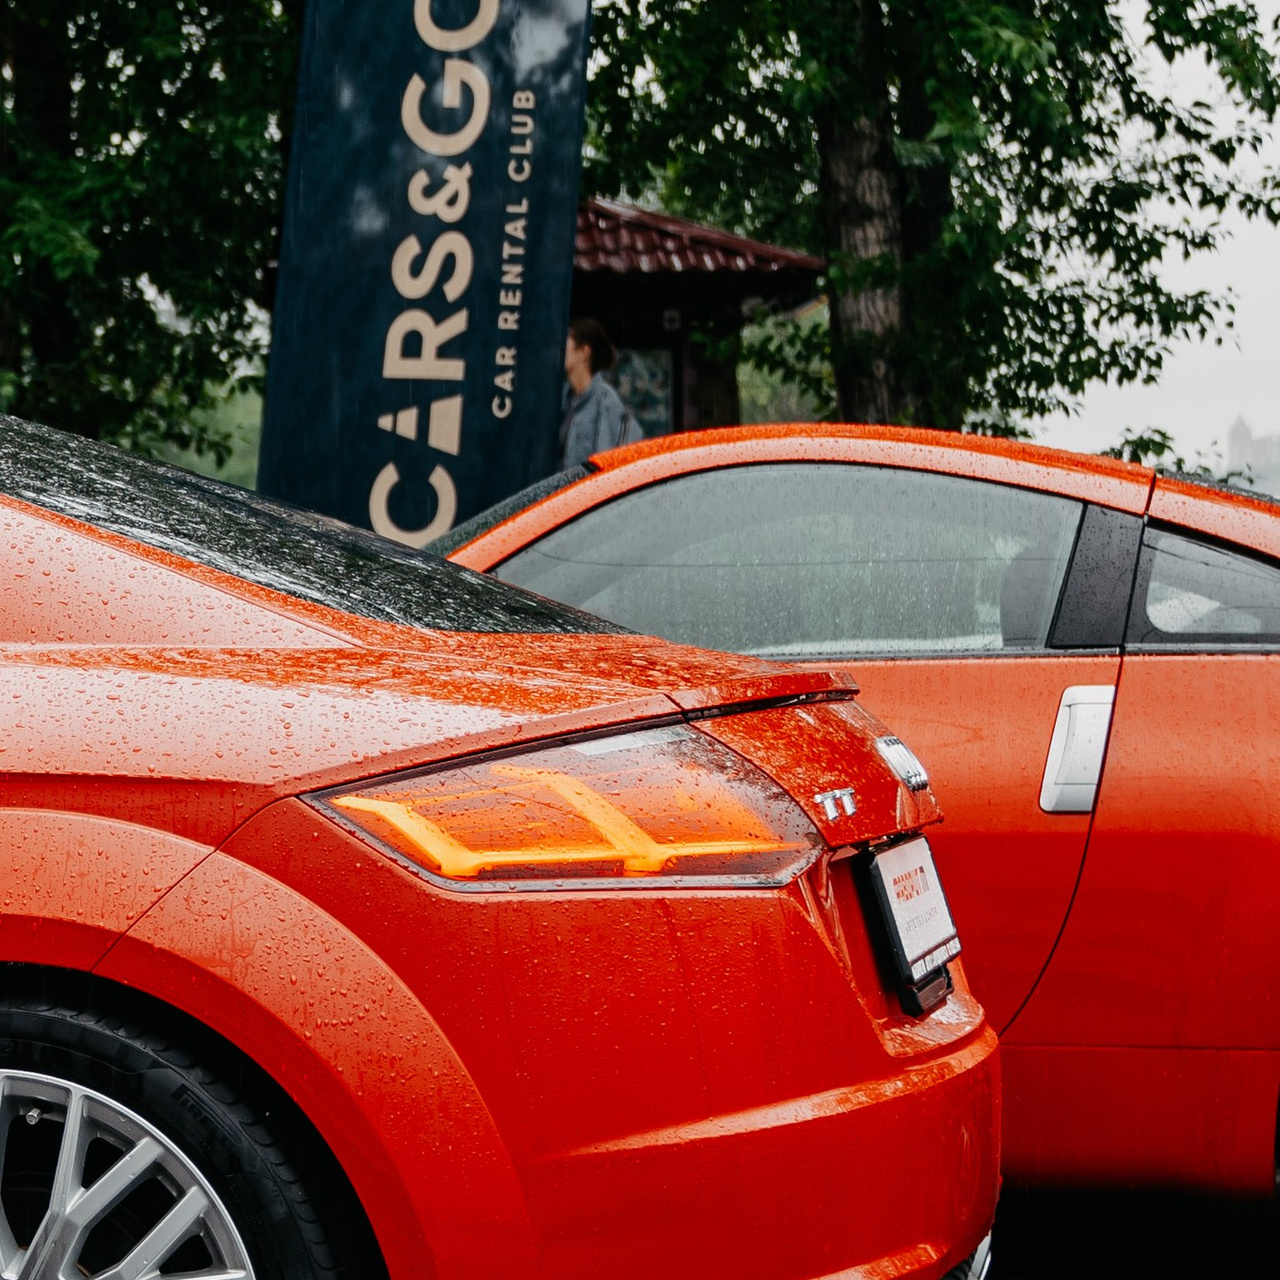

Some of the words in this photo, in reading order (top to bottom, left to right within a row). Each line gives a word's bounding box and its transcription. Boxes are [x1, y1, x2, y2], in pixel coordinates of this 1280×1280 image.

[507, 89, 536, 183] CLUB
[498, 197, 530, 330] RENTAL
[492, 345, 517, 419] CAR
[814, 787, 857, 820] TT
